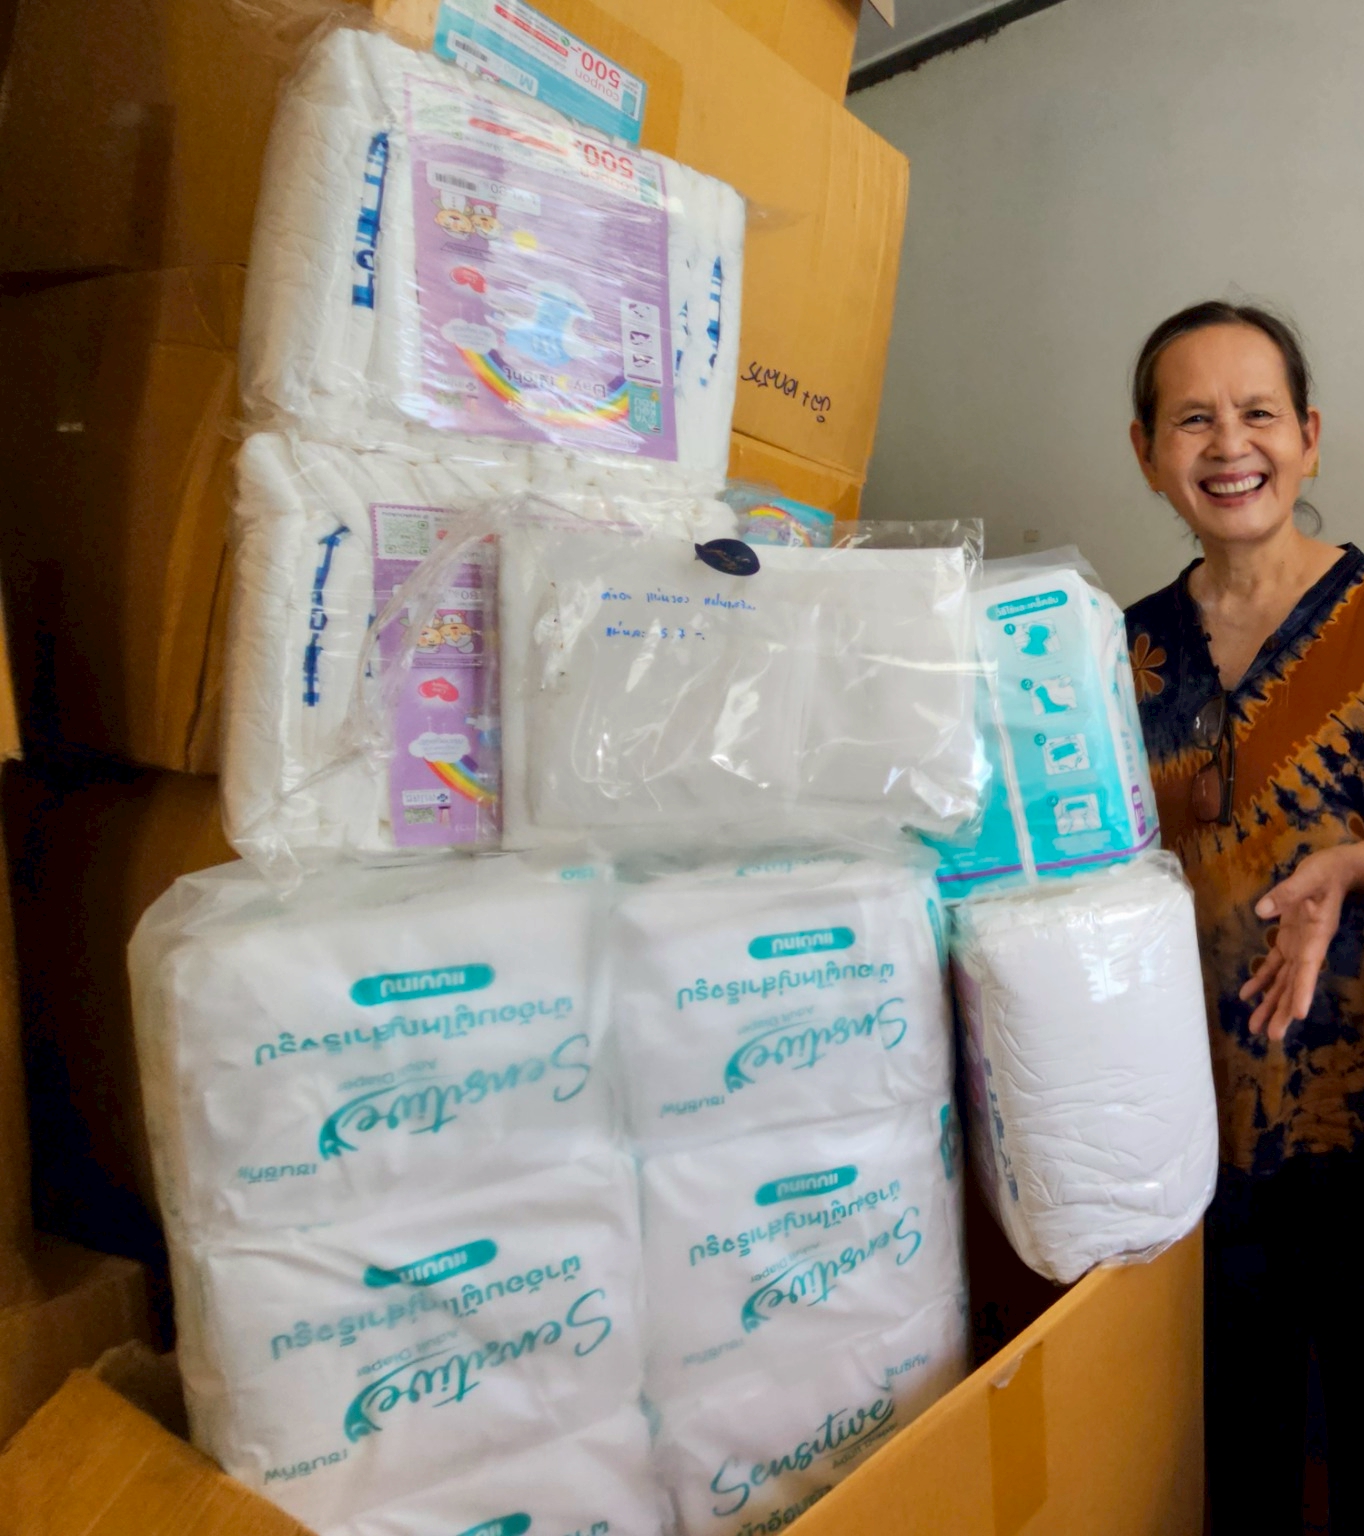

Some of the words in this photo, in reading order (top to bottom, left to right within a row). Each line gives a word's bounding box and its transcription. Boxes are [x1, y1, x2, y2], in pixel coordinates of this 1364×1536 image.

[574, 68, 621, 103] coupon
[771, 931, 834, 954] แบบเทป
[380, 969, 466, 997] แบบเทป
[340, 1032, 592, 1137] Sensitive
[776, 1172, 839, 1197] แบบเทป
[755, 1206, 923, 1311] Sensitive
[366, 1287, 613, 1413] Sensitive
[709, 1397, 894, 1518] Sensitive
